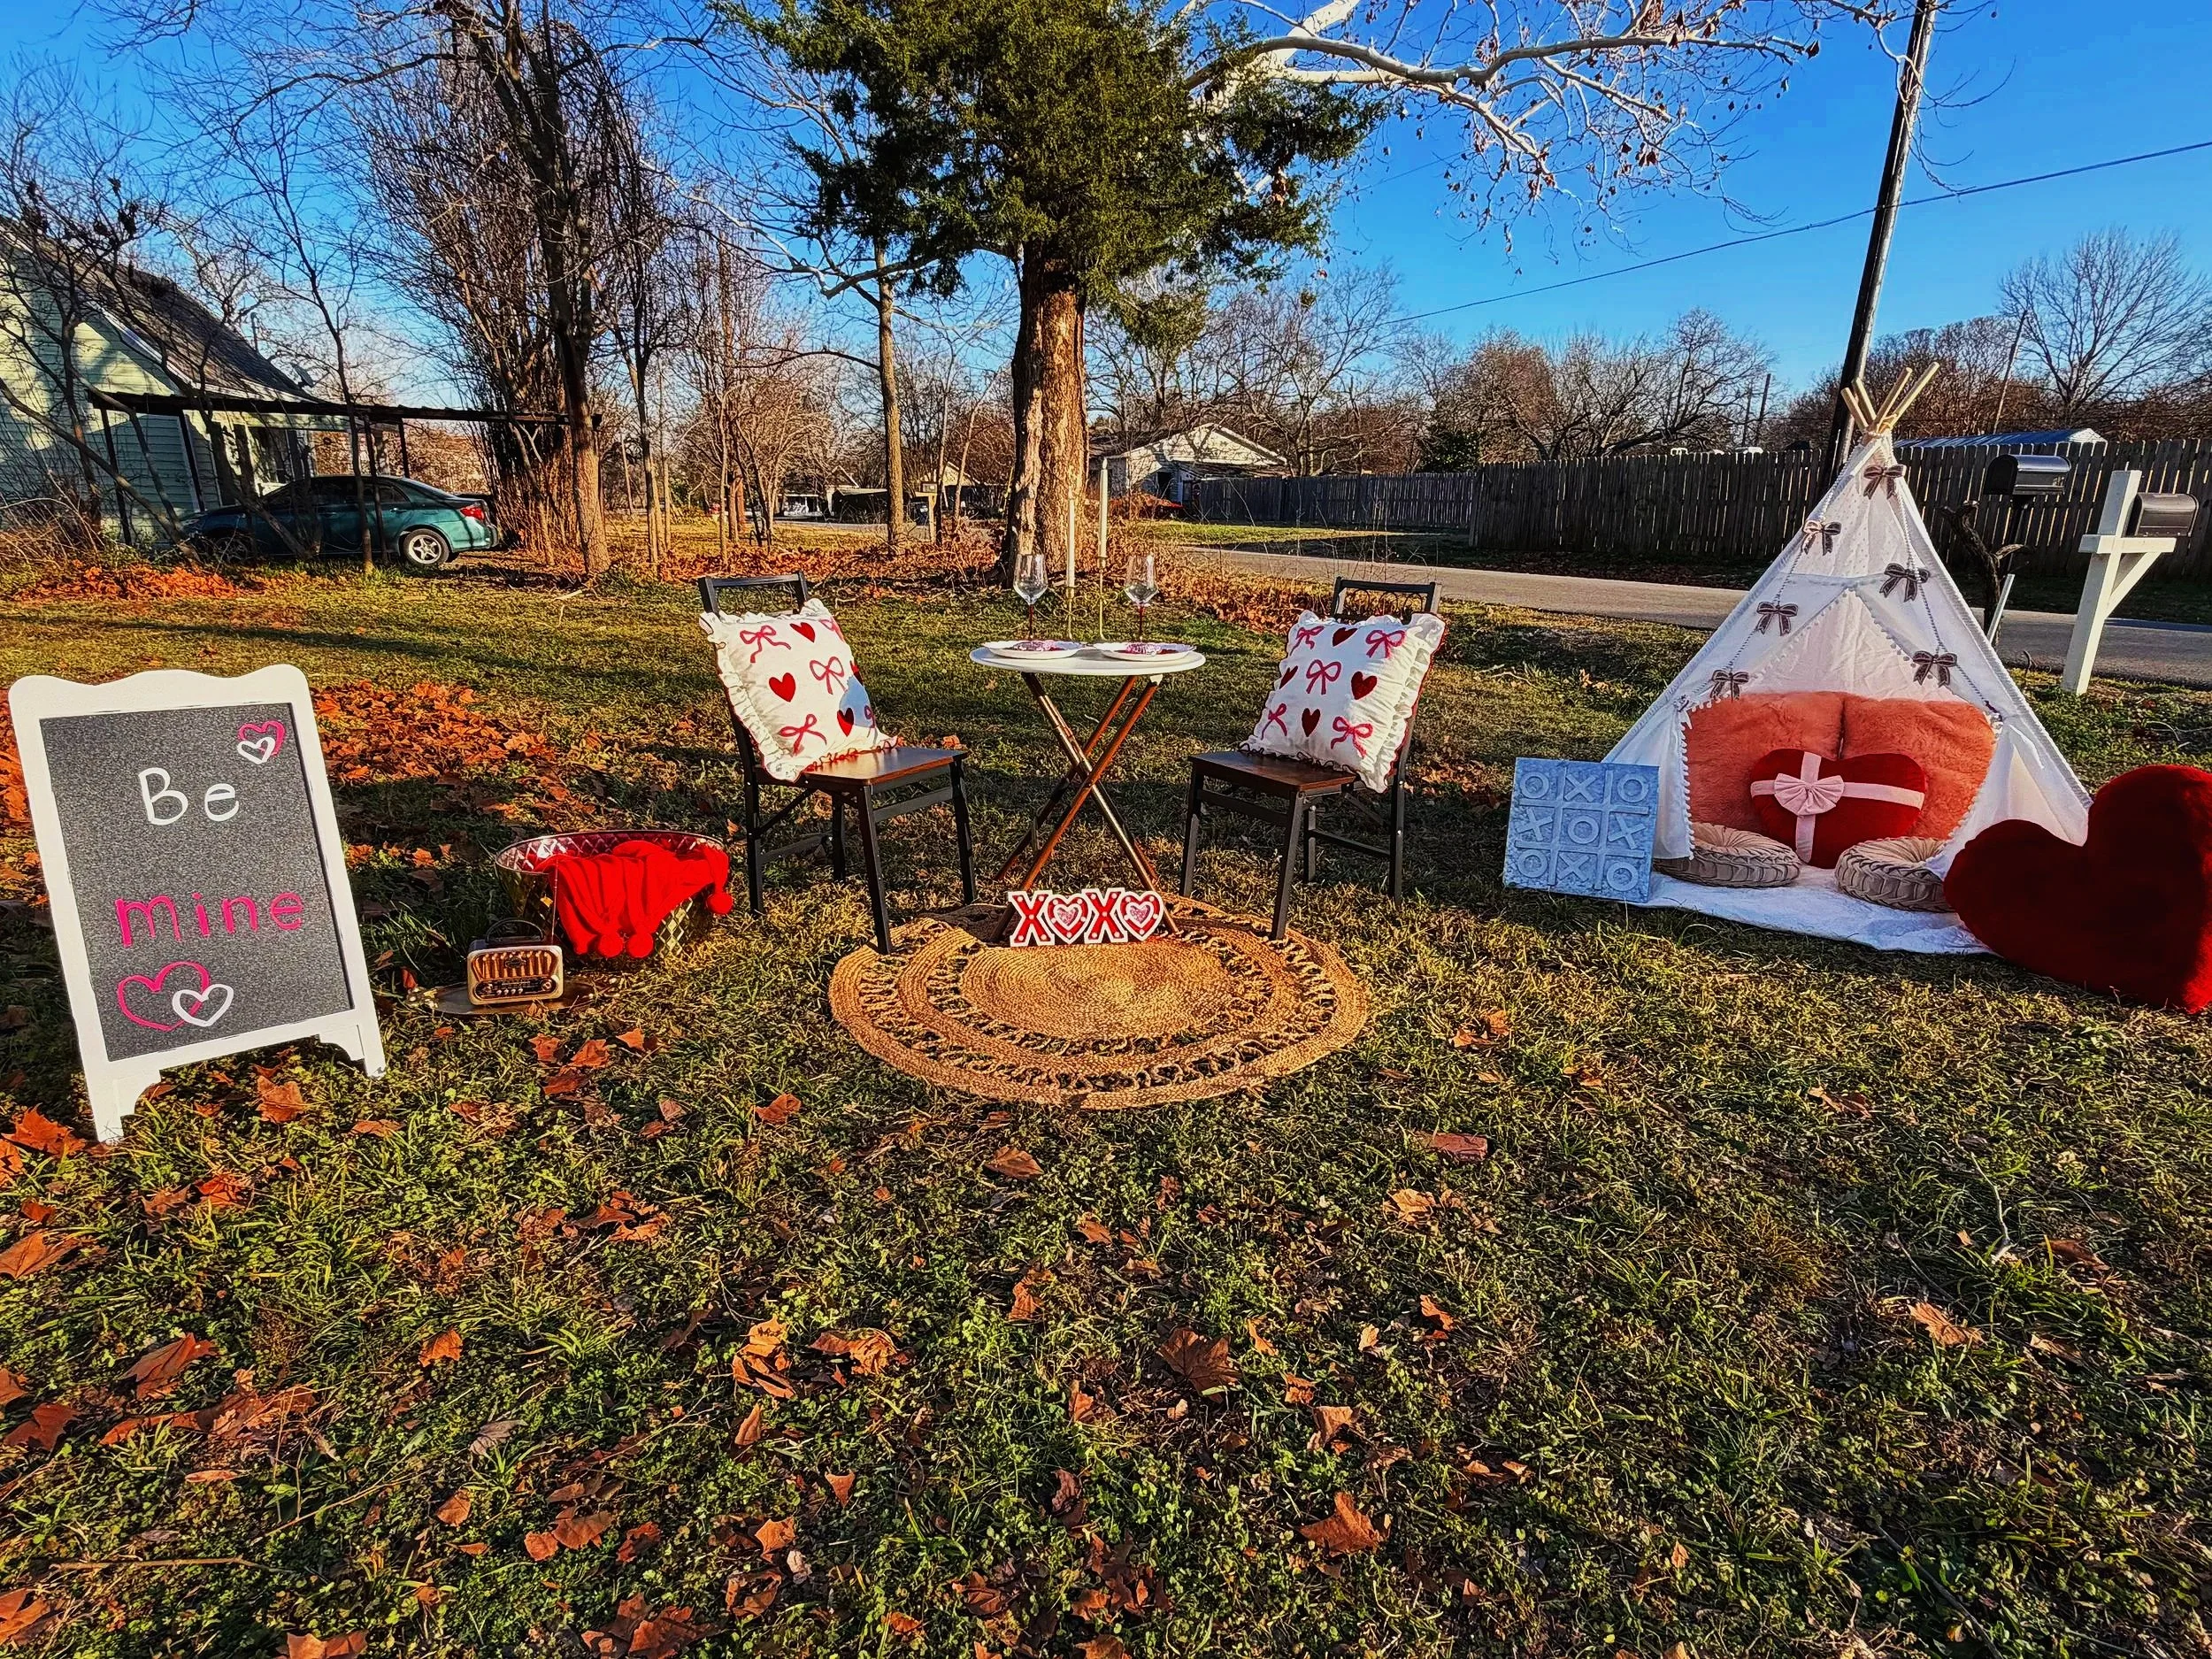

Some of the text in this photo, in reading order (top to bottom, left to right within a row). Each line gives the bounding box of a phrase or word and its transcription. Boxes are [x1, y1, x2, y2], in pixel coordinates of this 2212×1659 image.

[138, 767, 240, 826] Be
[115, 892, 304, 948] mine
[1009, 887, 1164, 947] XOXO
